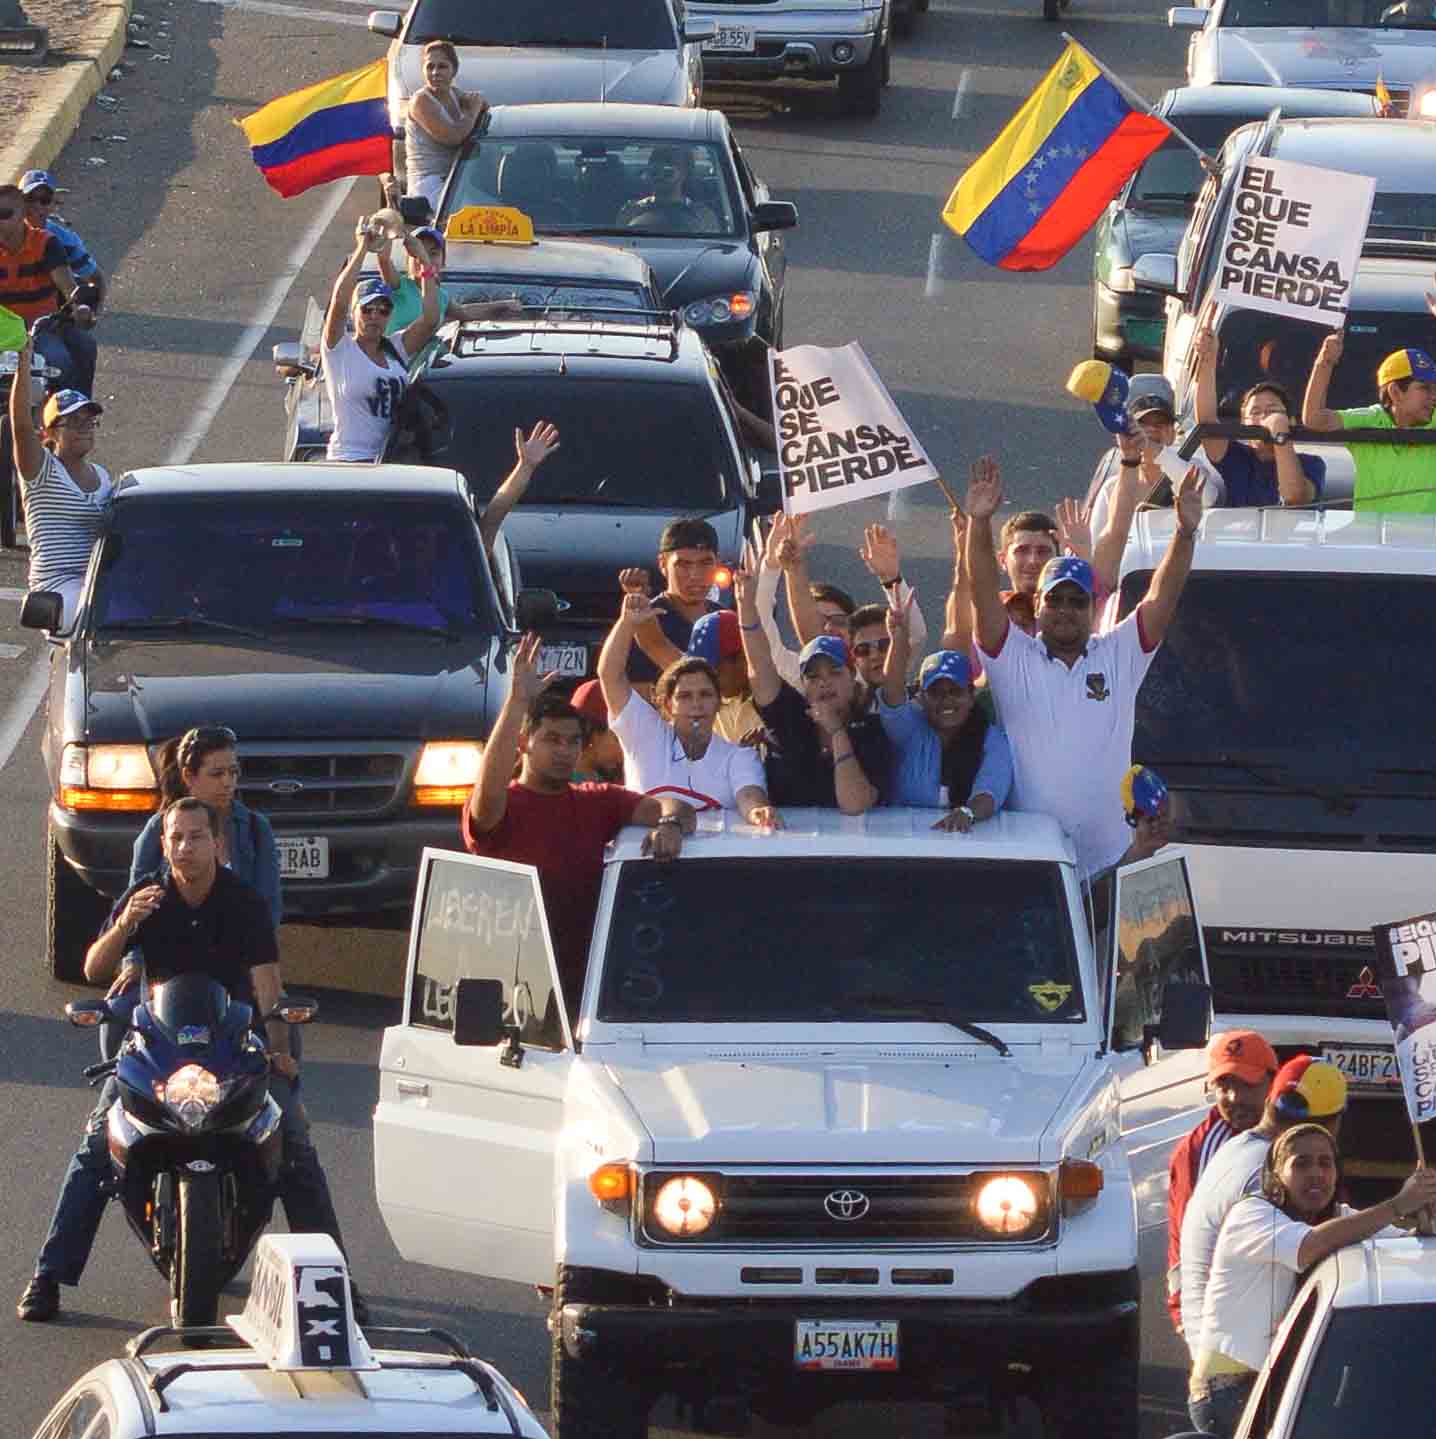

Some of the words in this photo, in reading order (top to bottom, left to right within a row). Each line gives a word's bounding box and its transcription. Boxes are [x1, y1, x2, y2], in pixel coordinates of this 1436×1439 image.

[1240, 165, 1284, 196] EL
[1235, 191, 1313, 228] QUE
[1231, 216, 1279, 247] SE
[1225, 242, 1349, 291] CANSA,
[1220, 266, 1348, 315] PIERDE.
[775, 376, 840, 411] QUE
[779, 410, 822, 441] SE
[1223, 931, 1376, 946] MITSUBIS
[801, 1332, 893, 1359] A55AK7H
